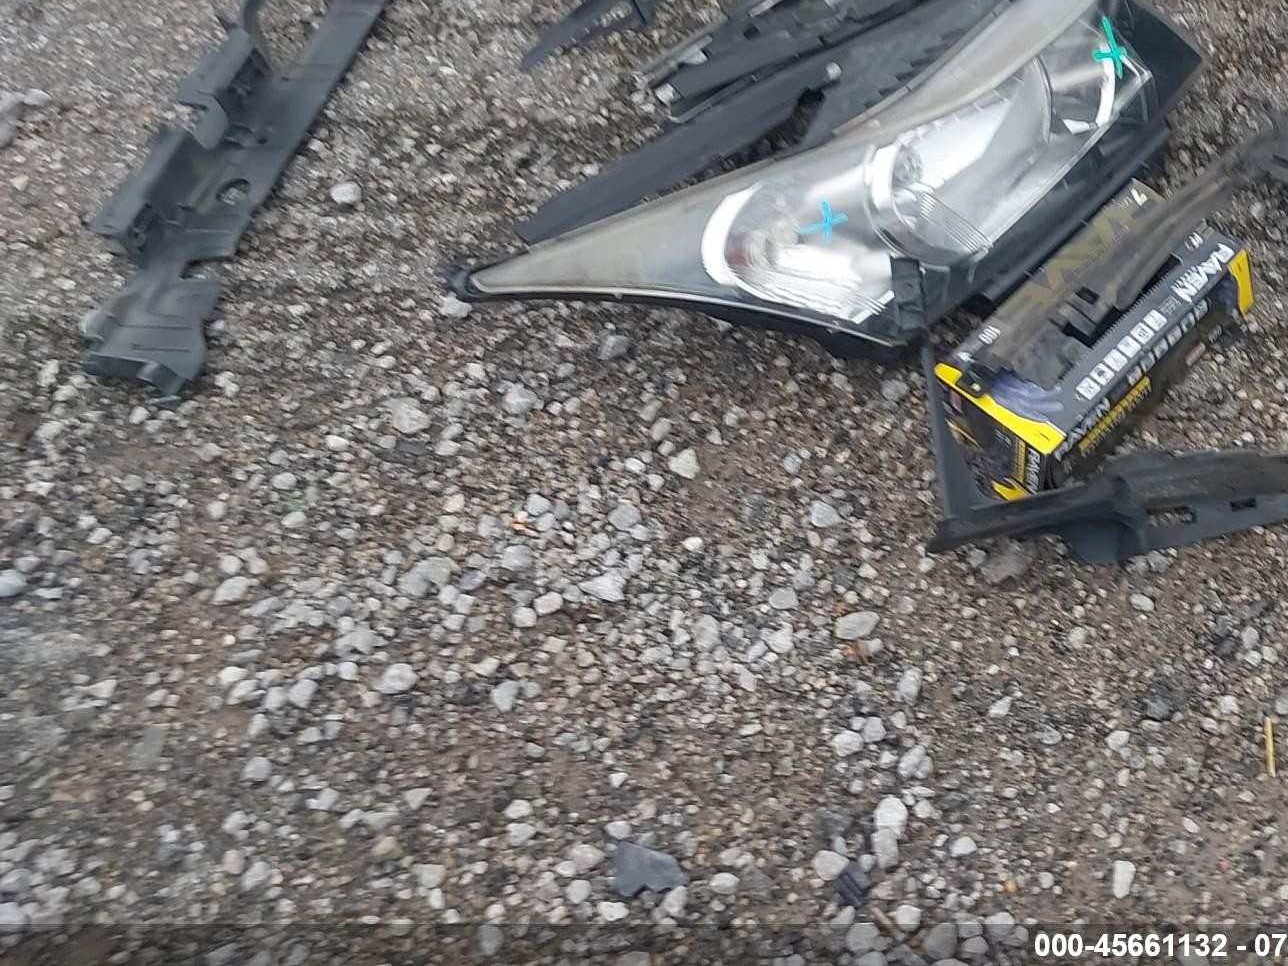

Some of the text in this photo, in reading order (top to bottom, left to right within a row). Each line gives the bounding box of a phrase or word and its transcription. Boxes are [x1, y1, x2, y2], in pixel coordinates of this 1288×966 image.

[1171, 242, 1234, 302] RAVEN
[978, 325, 1001, 345] 100
[1025, 447, 1041, 495] RAVEN
